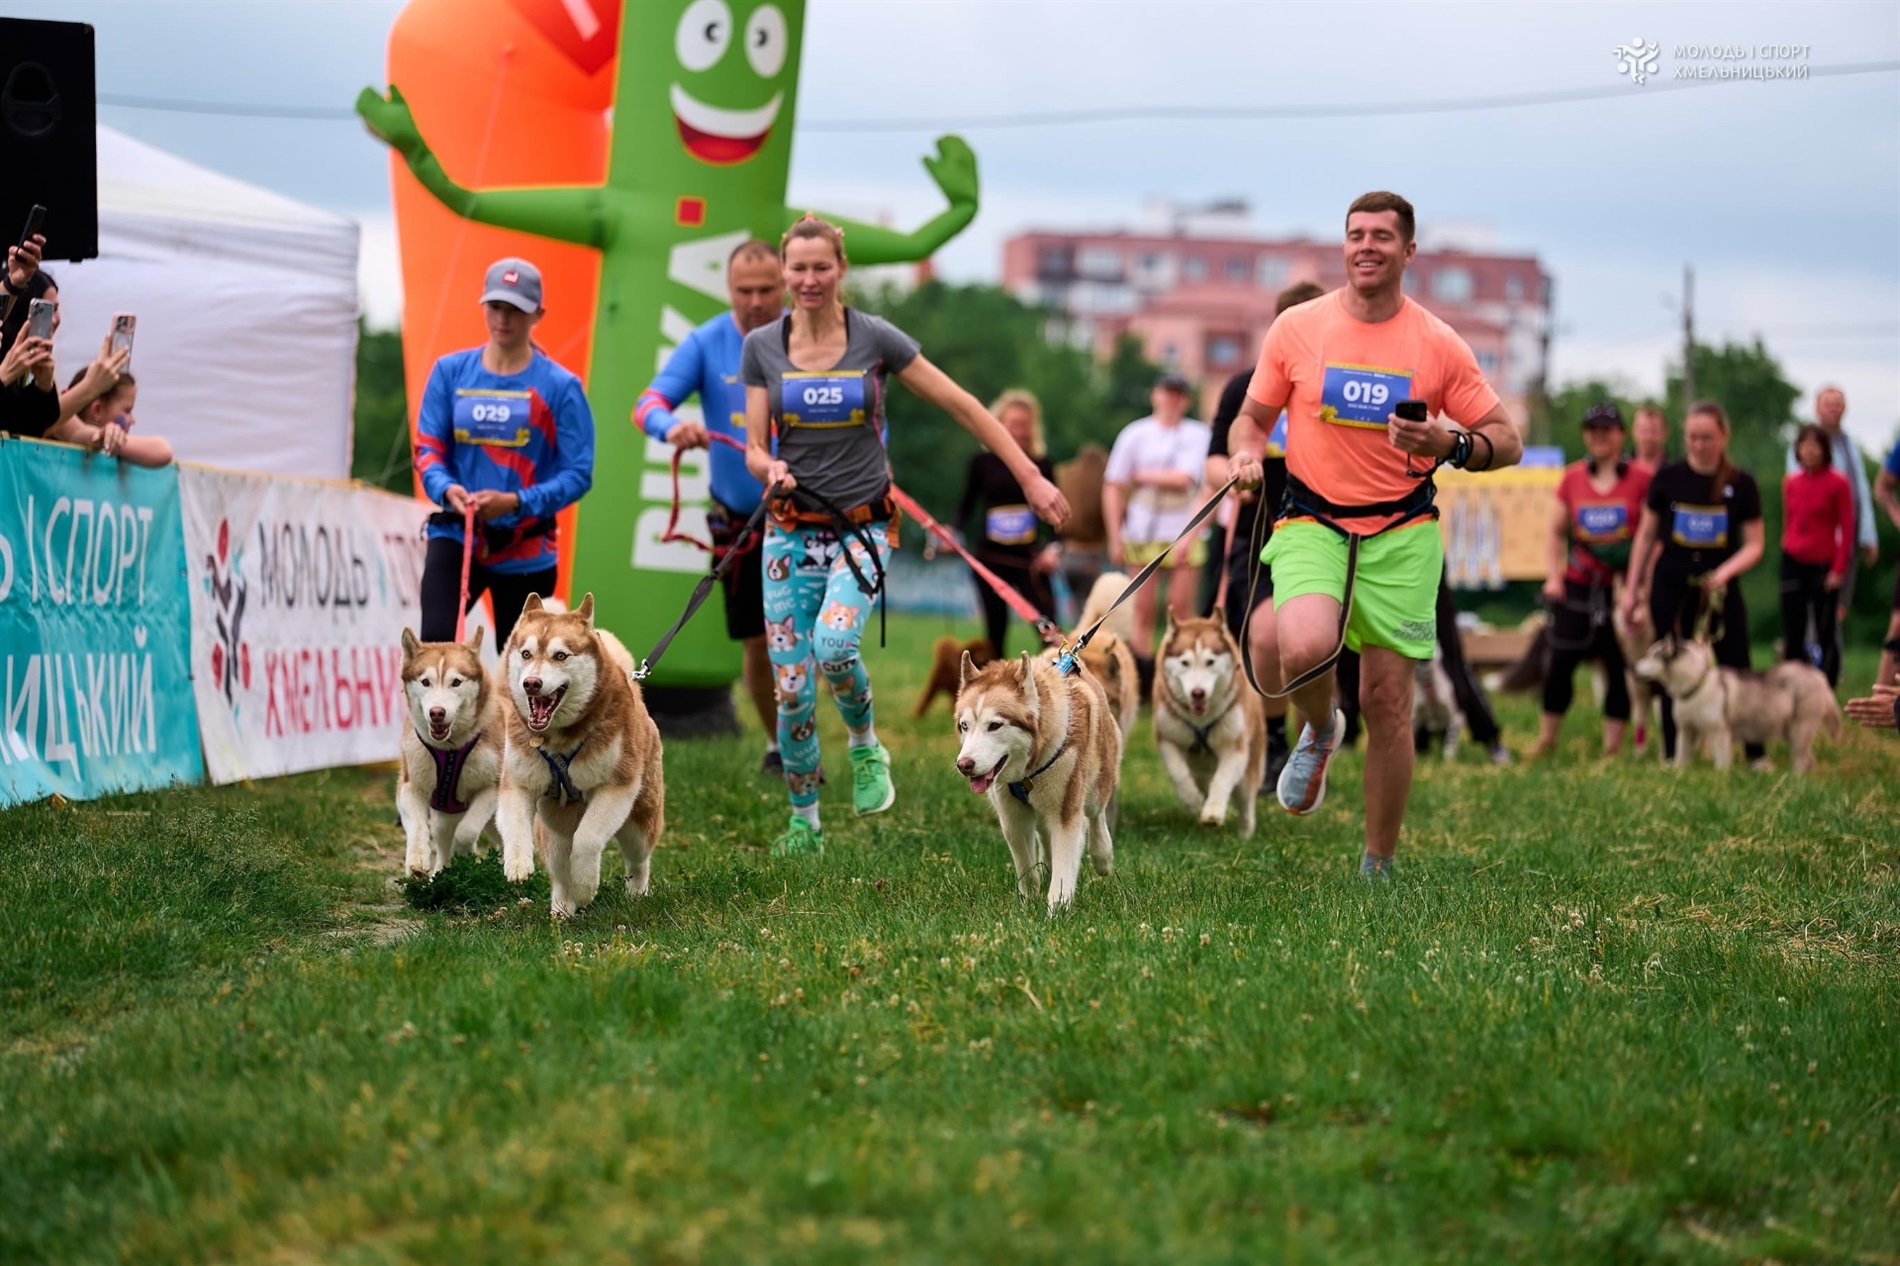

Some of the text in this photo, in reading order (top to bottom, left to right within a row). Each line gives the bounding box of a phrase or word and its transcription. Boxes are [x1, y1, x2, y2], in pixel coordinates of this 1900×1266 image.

[472, 404, 511, 423] 029
[803, 387, 844, 405] 025
[1343, 380, 1389, 405] 019
[45, 496, 153, 606] СПОРТ
[258, 521, 371, 625] МОЛОДЬ
[821, 636, 845, 648] YOU
[0, 625, 156, 782] ИЦЬКИЙ
[264, 645, 401, 738] ХМЕЛЬНИ
